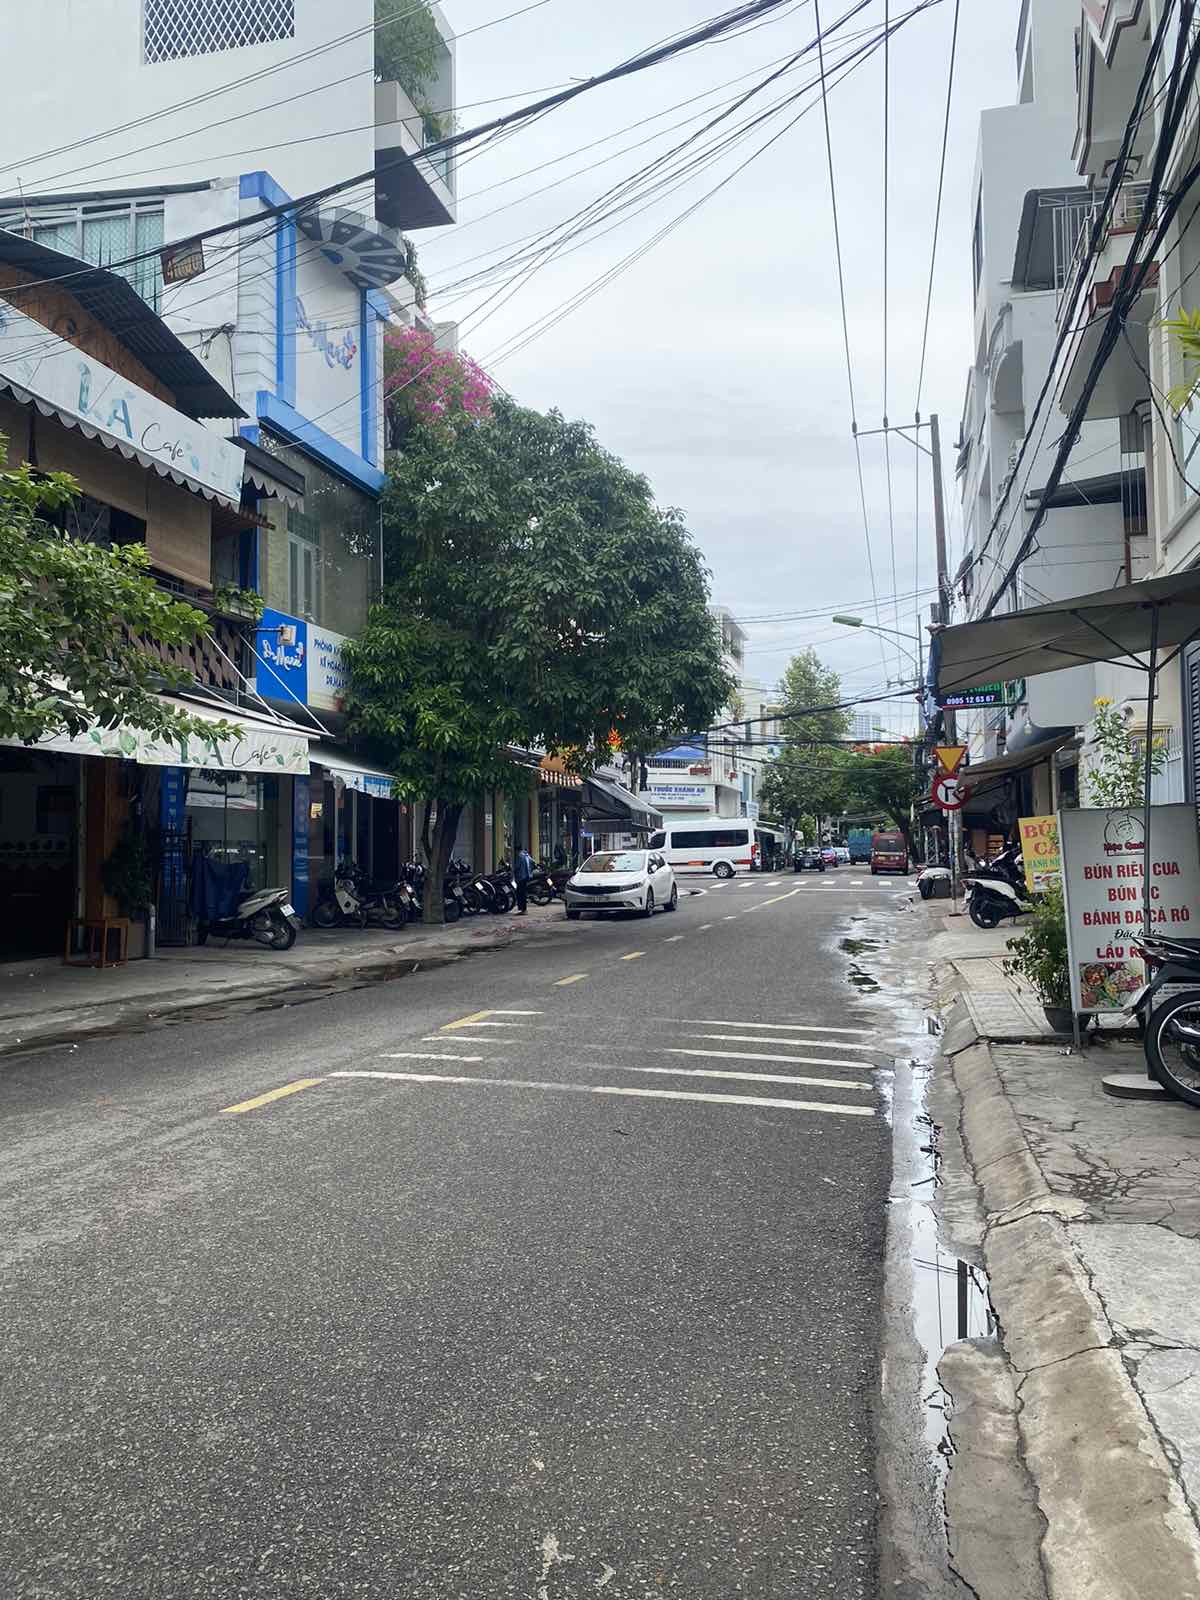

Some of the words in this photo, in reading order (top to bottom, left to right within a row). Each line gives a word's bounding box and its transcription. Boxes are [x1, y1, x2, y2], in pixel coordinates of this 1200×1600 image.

[1084, 863, 1112, 880] BÚN
[1152, 861, 1180, 876] CUA
[1108, 884, 1137, 901] BÚN
[1083, 909, 1121, 926] BÁNH
